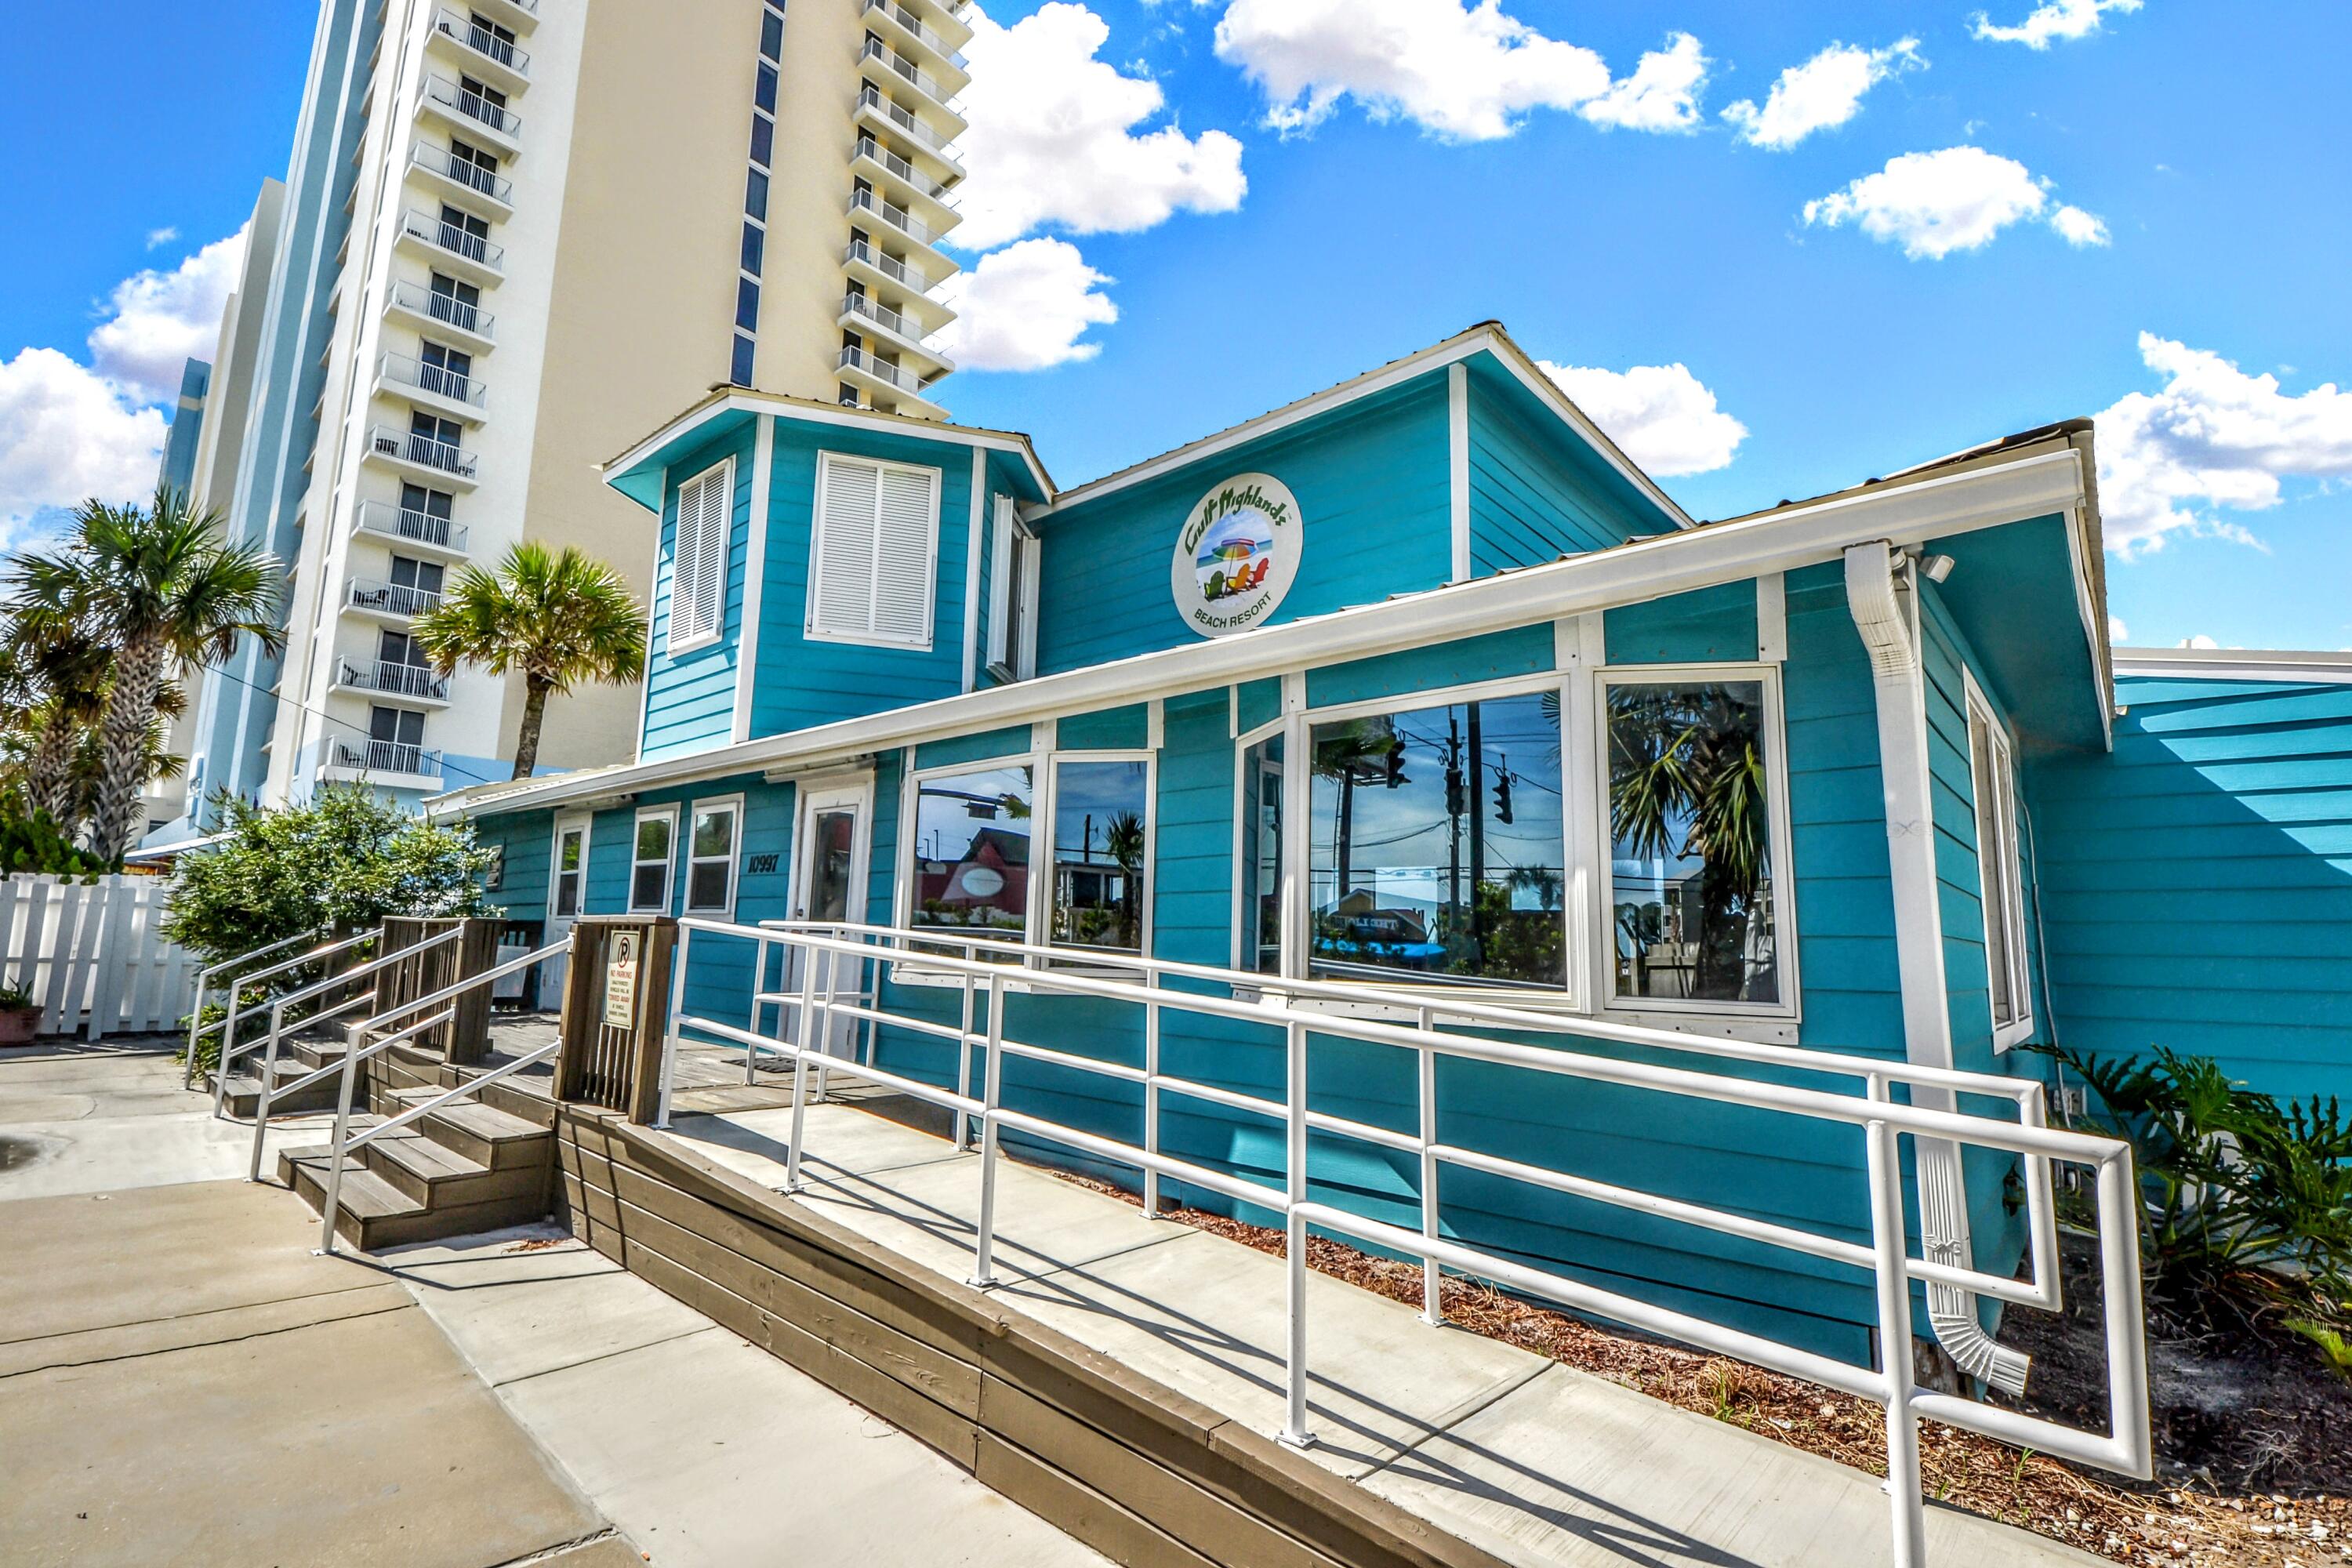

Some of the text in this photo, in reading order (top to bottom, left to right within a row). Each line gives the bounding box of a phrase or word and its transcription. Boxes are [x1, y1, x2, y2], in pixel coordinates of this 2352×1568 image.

[1185, 484, 1287, 556] Gulf Highlands
[1194, 591, 1272, 628] BEACH RESORT
[747, 854, 780, 873] 10997
